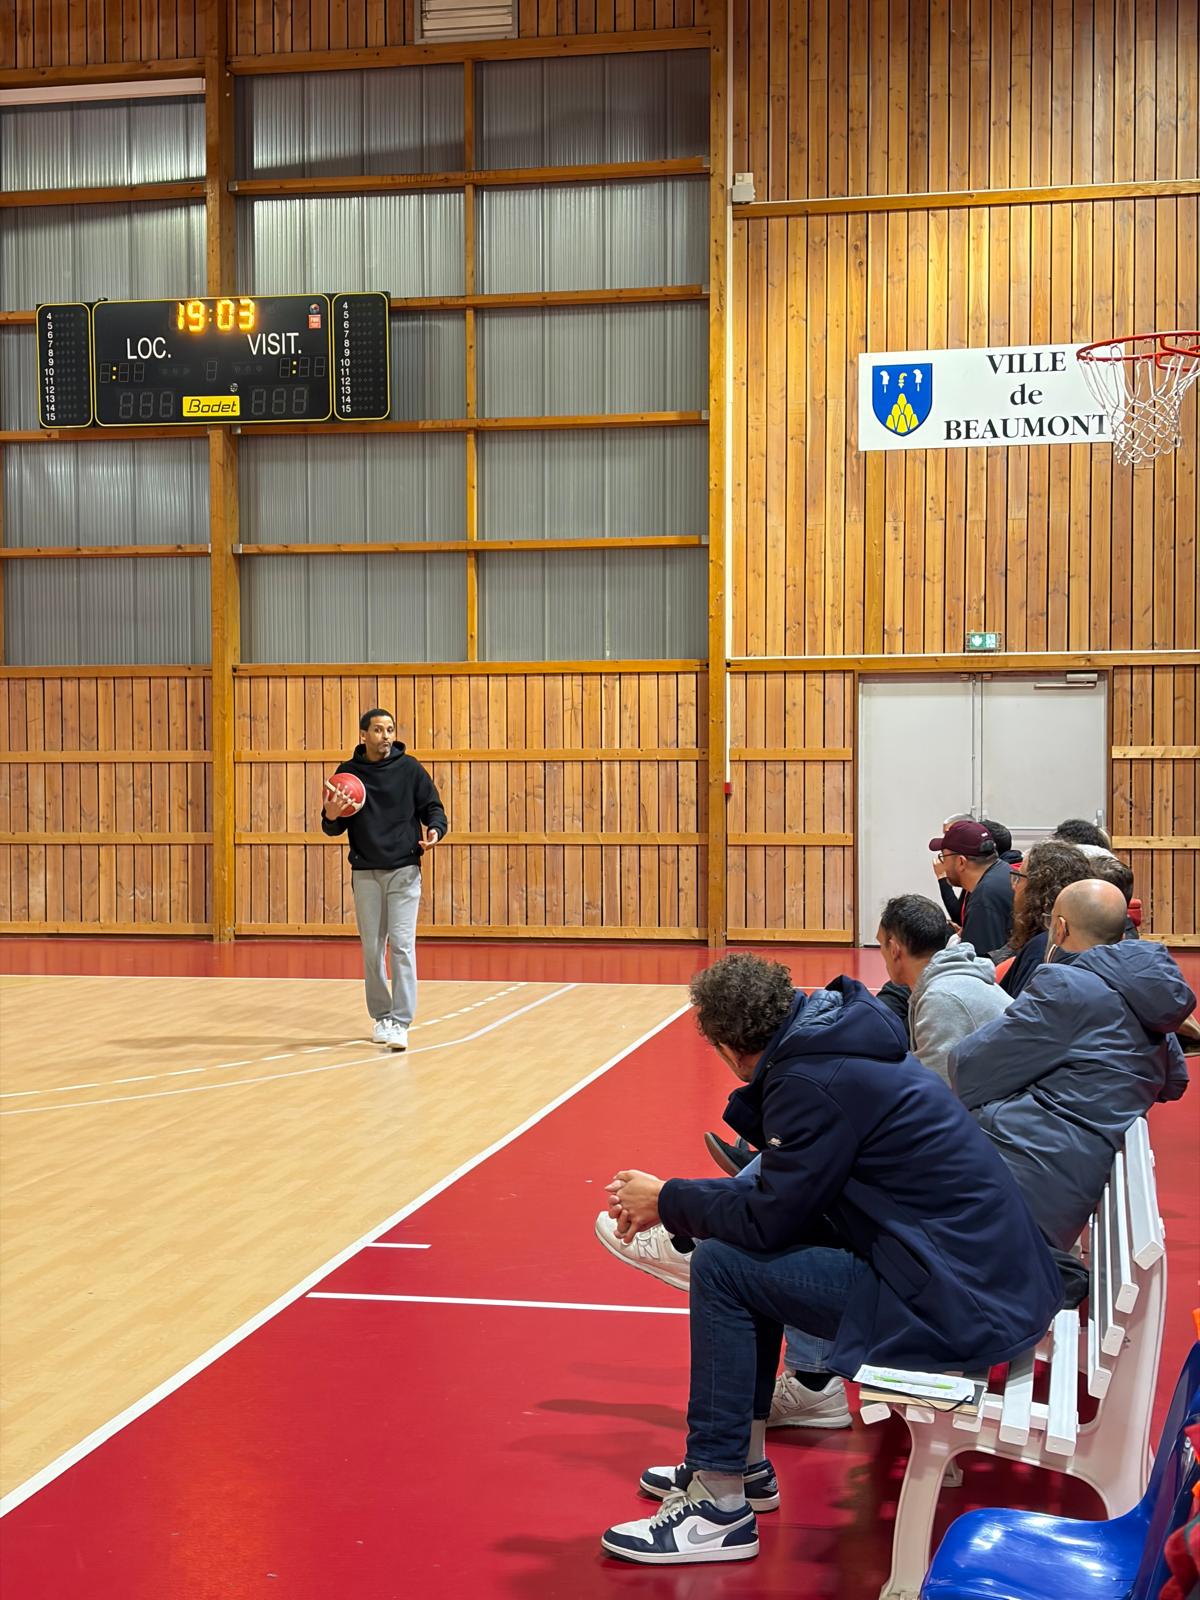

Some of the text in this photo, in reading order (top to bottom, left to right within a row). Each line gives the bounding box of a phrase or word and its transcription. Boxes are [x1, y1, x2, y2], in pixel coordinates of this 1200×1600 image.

[177, 298, 255, 332] 19:03
[126, 336, 172, 360] LOC.
[246, 332, 302, 356] VISIT.
[344, 339, 350, 347] 8
[987, 351, 1067, 375] VILLE
[341, 386, 351, 394] 13
[1010, 383, 1043, 406] de
[186, 398, 237, 413] Bodet
[943, 414, 1108, 441] BEAUMONT
